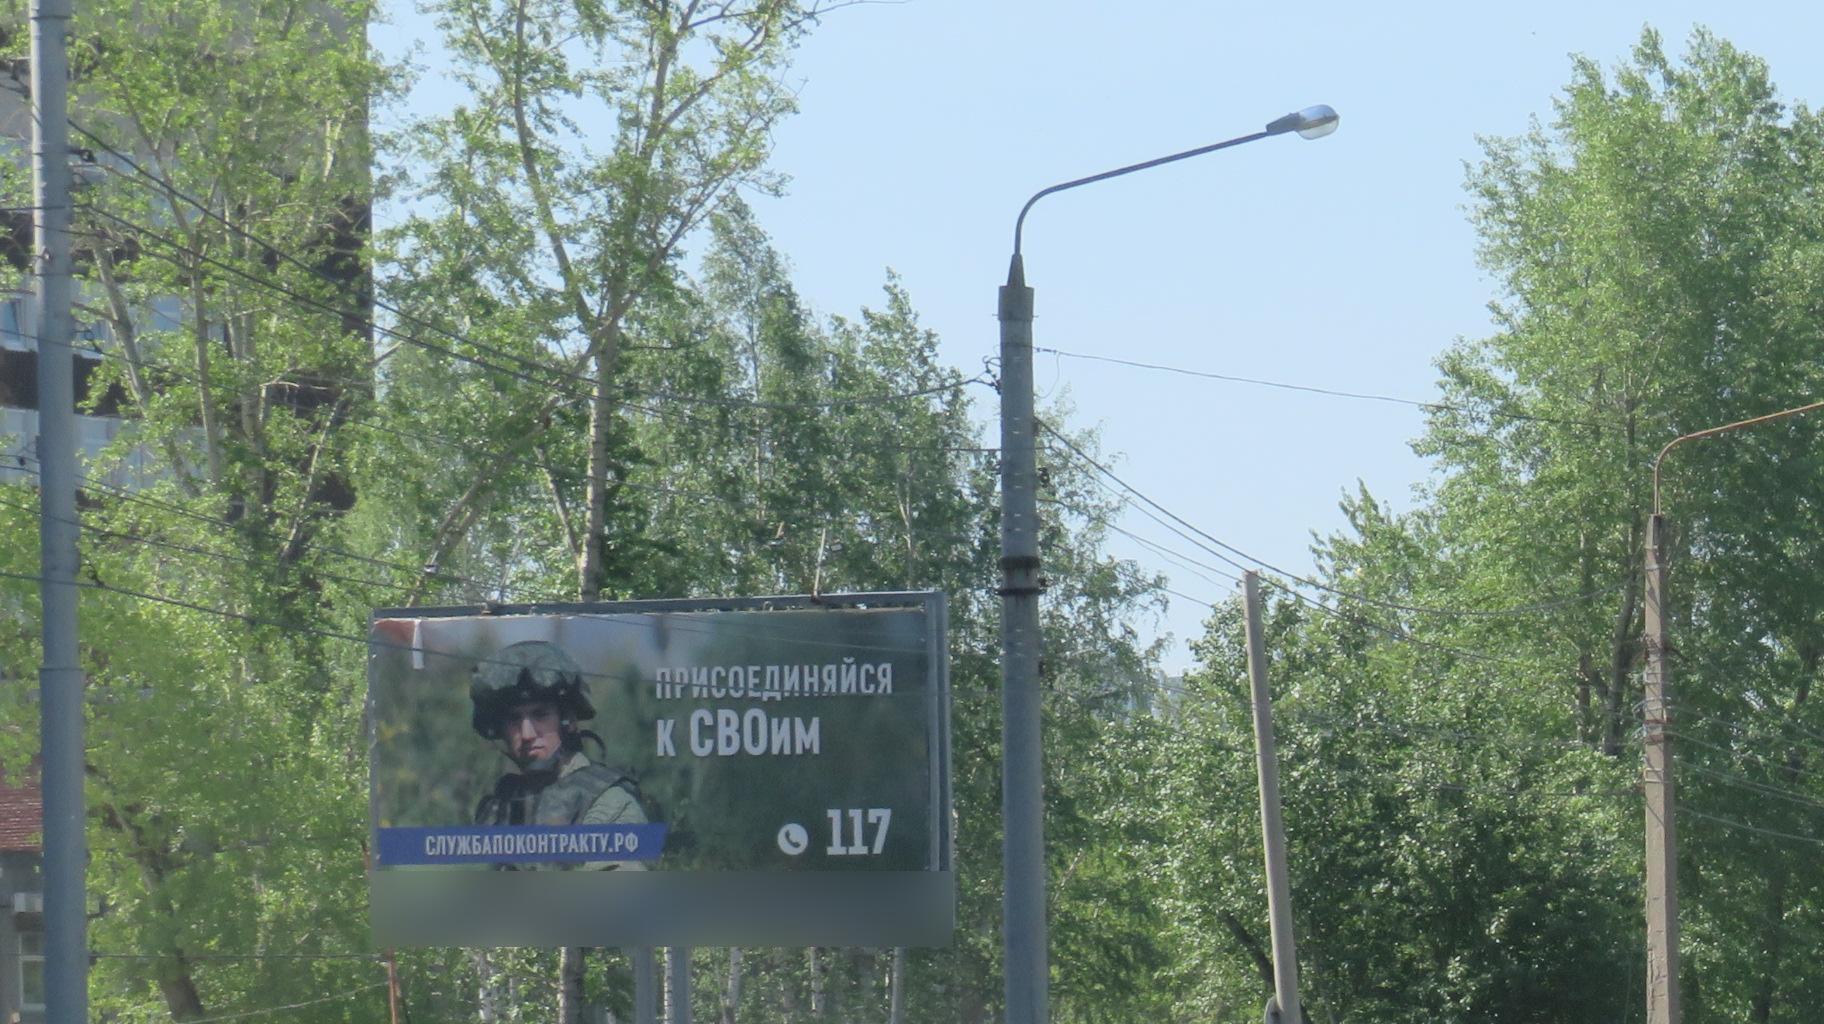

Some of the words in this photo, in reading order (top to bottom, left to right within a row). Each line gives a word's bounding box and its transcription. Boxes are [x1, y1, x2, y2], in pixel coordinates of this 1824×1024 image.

[656, 657, 893, 701] ПРИСОЕДИНЯЙСЯ
[425, 832, 639, 856] СЛУЖБАПОКОНТРАКТУ.РФ
[826, 808, 891, 855] 117
